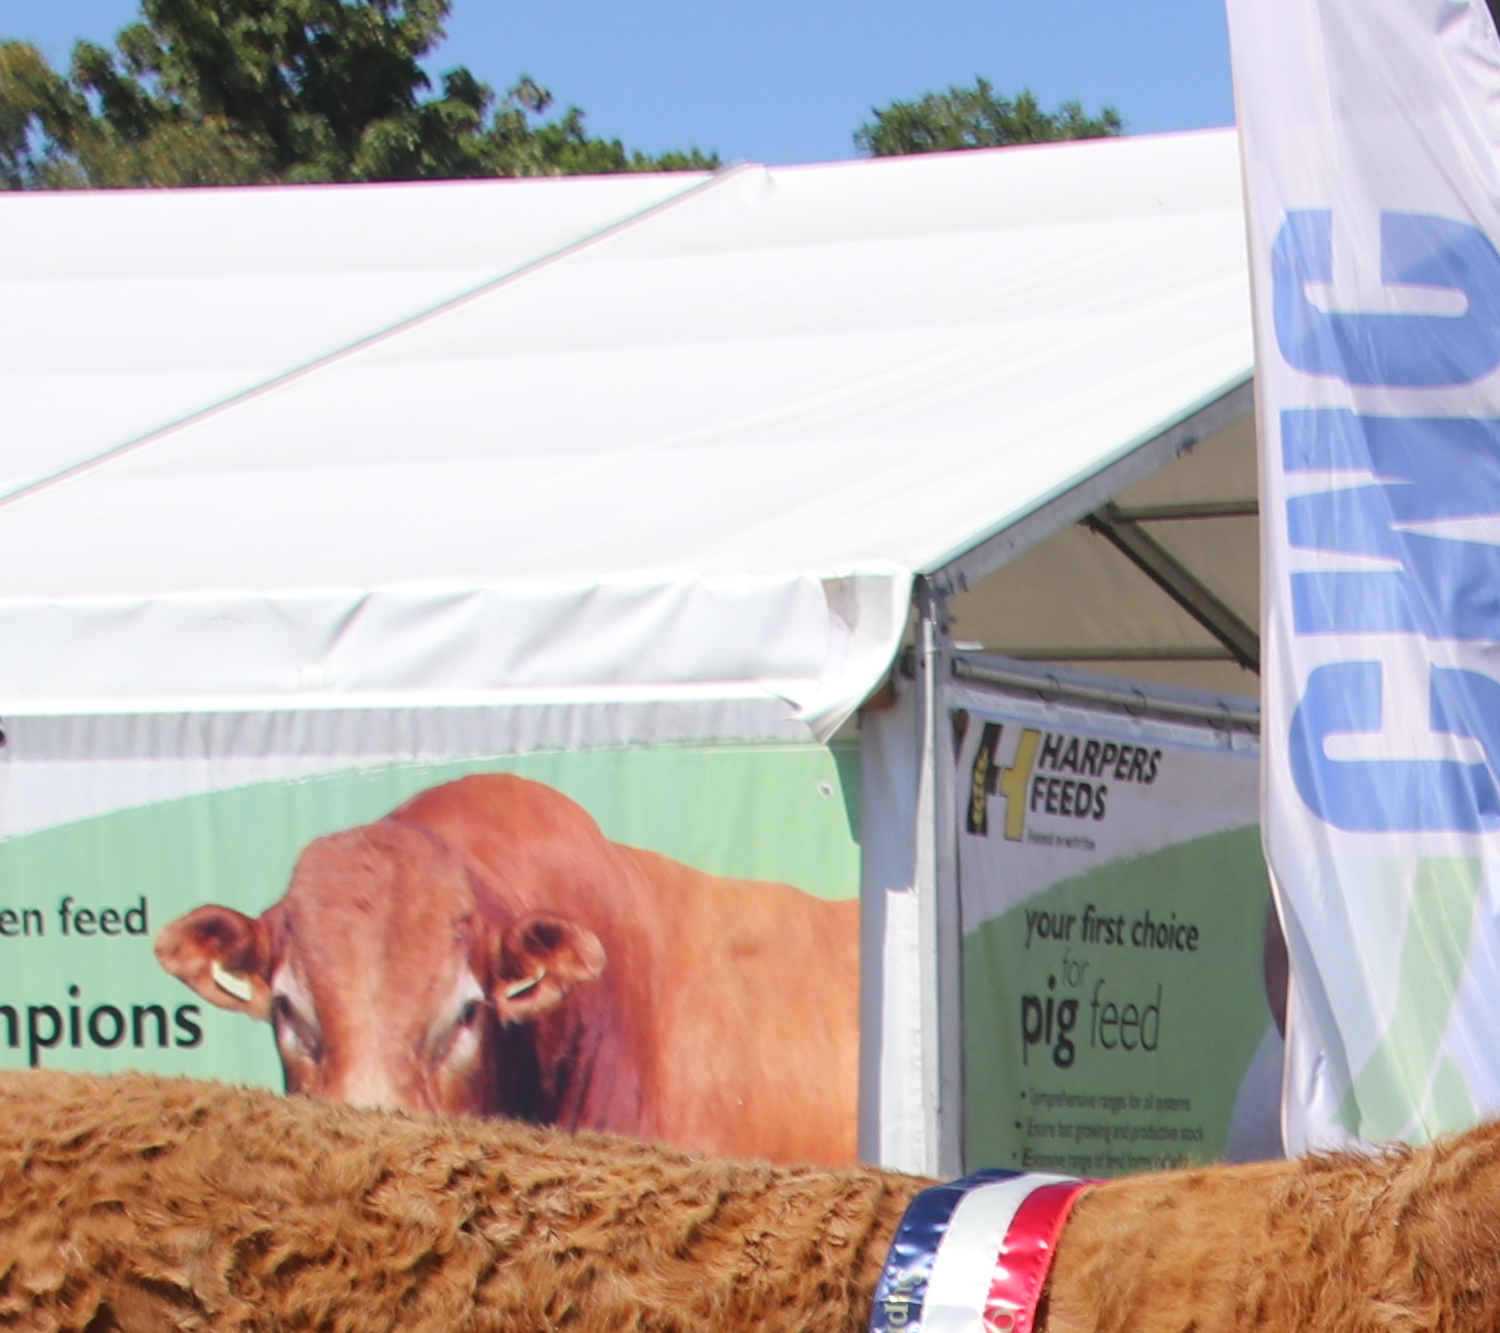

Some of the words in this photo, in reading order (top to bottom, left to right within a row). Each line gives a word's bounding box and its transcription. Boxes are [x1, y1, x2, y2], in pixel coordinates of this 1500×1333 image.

[1038, 732, 1162, 785] HARPERS
[1030, 776, 1108, 821] FEEDS
[59, 896, 149, 936] feed
[1025, 909, 1077, 951] your
[1082, 903, 1127, 946] first
[1131, 908, 1200, 952] choice
[1062, 946, 1091, 988] for
[1021, 973, 1080, 1070] pig
[1089, 977, 1162, 1052] feed
